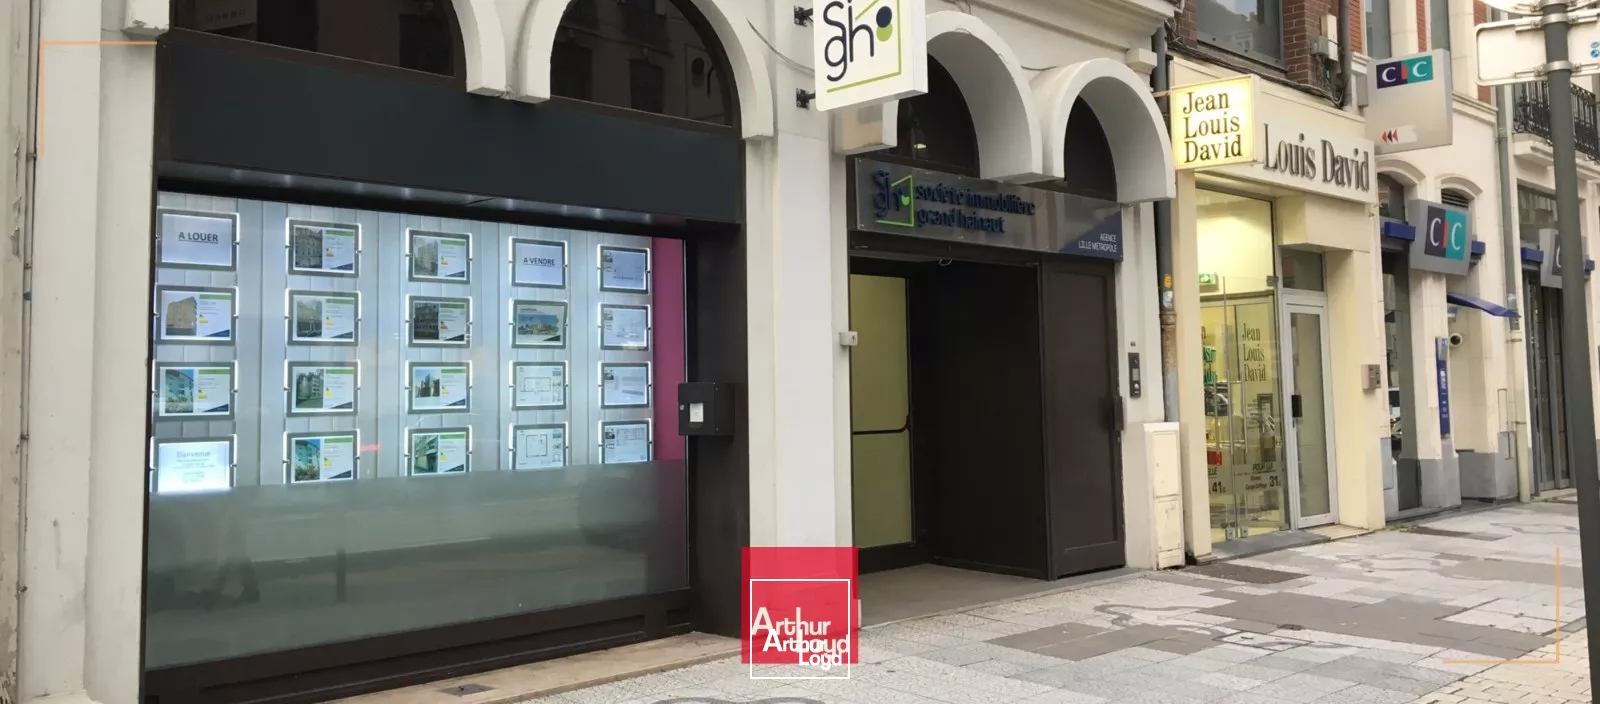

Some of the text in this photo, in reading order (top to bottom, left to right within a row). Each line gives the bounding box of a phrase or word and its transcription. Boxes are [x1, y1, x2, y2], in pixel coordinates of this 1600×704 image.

[1381, 61, 1428, 83] CIC
[1182, 91, 1230, 115] Jean
[1183, 112, 1241, 140] Louis
[1184, 134, 1243, 164] David
[1262, 123, 1371, 193] Louis David
[916, 208, 1006, 234] grand hainaut
[178, 231, 219, 243] A LOUER
[1078, 239, 1092, 250] LILLE
[1099, 232, 1117, 243] AGENCE
[1429, 216, 1463, 252] CIC
[523, 257, 556, 266] A VENDRE
[1241, 322, 1261, 342] Jean
[1243, 343, 1265, 362] Louis
[1243, 363, 1267, 382] David
